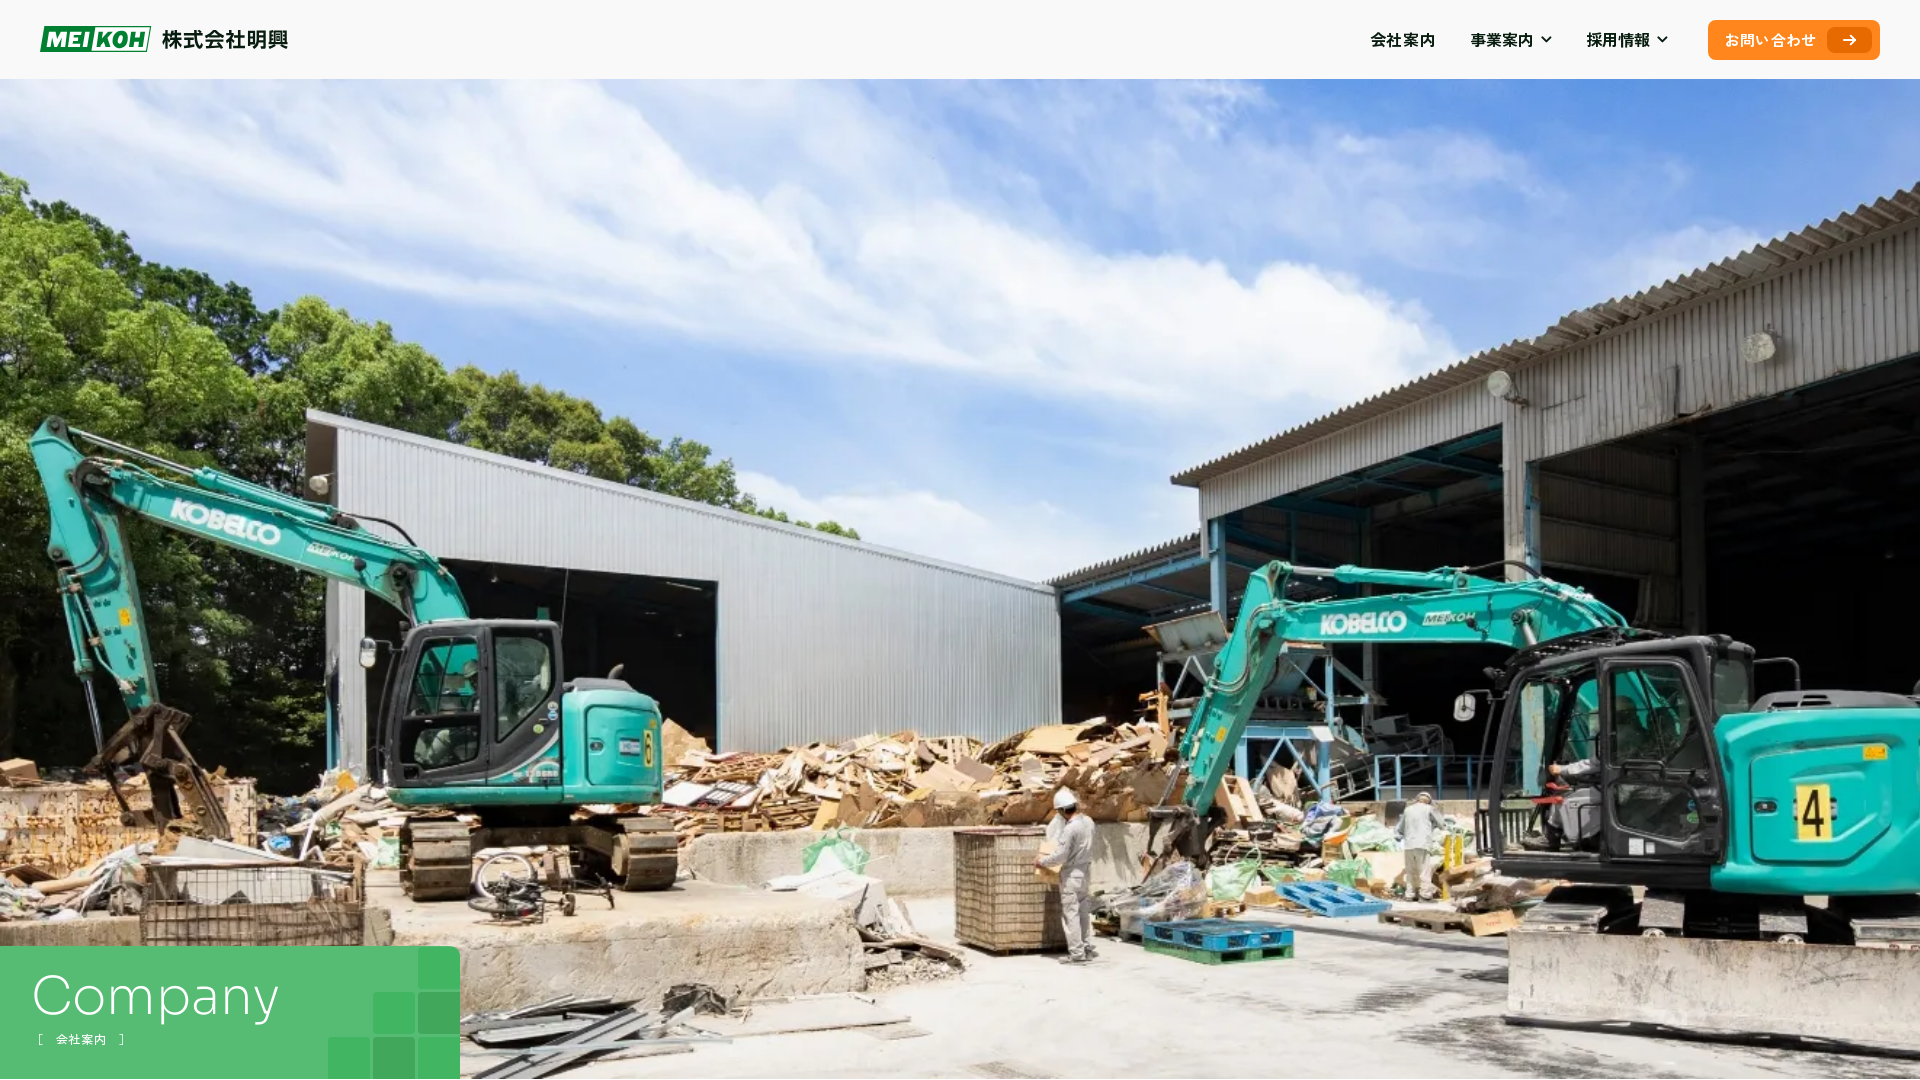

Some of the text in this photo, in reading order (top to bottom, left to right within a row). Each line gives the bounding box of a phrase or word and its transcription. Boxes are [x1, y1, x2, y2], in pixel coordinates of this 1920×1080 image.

[170, 498, 281, 545] KOBELCO
[1320, 611, 1407, 635] KOBELCO
[1802, 789, 1824, 837] 4
